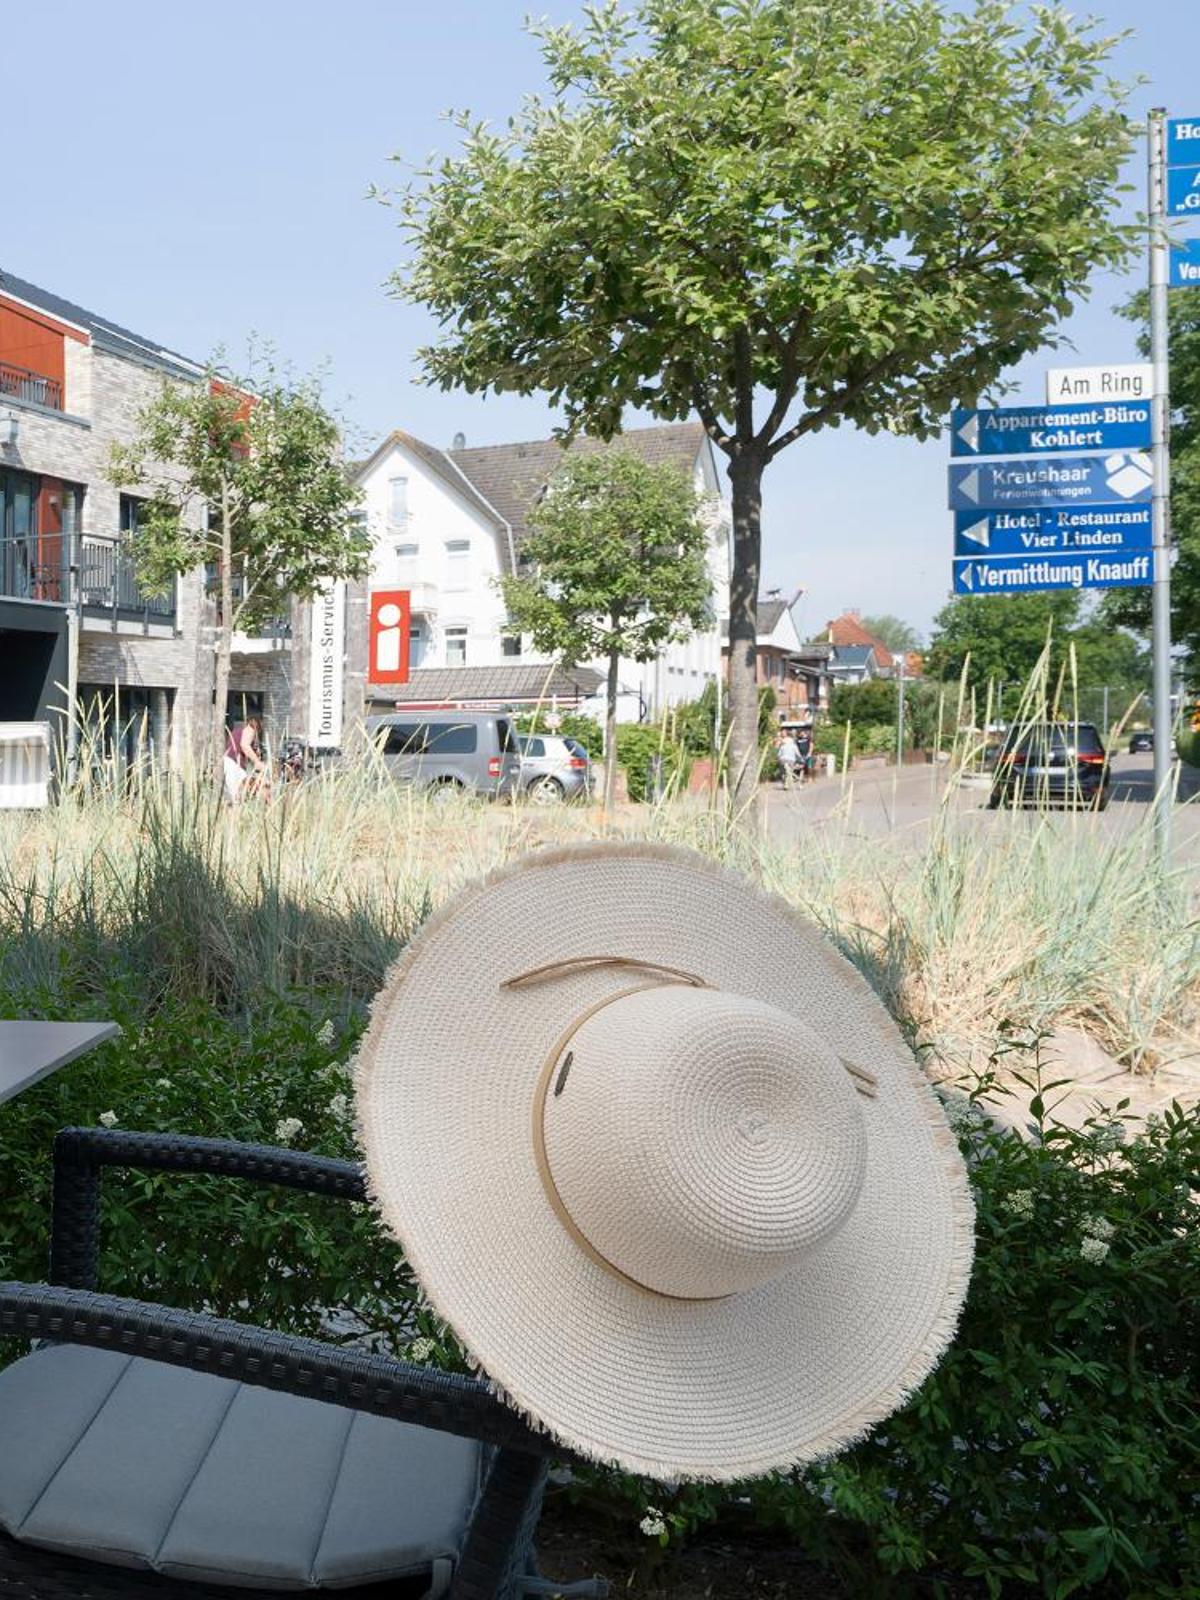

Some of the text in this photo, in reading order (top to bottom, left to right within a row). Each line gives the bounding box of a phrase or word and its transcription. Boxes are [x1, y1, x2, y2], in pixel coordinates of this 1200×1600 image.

[1060, 372, 1143, 395] Am Ring
[985, 406, 1148, 431] Appartement-Büro
[1030, 430, 1103, 448] Kohlert
[992, 467, 1091, 485] Kraushaar
[995, 513, 1041, 529] Hotel
[1057, 510, 1149, 527] Restaurant
[1020, 529, 1124, 548] Vier Linden
[976, 557, 1149, 587] Vermittlung Knauff
[318, 586, 336, 737] Tourismus-Service
